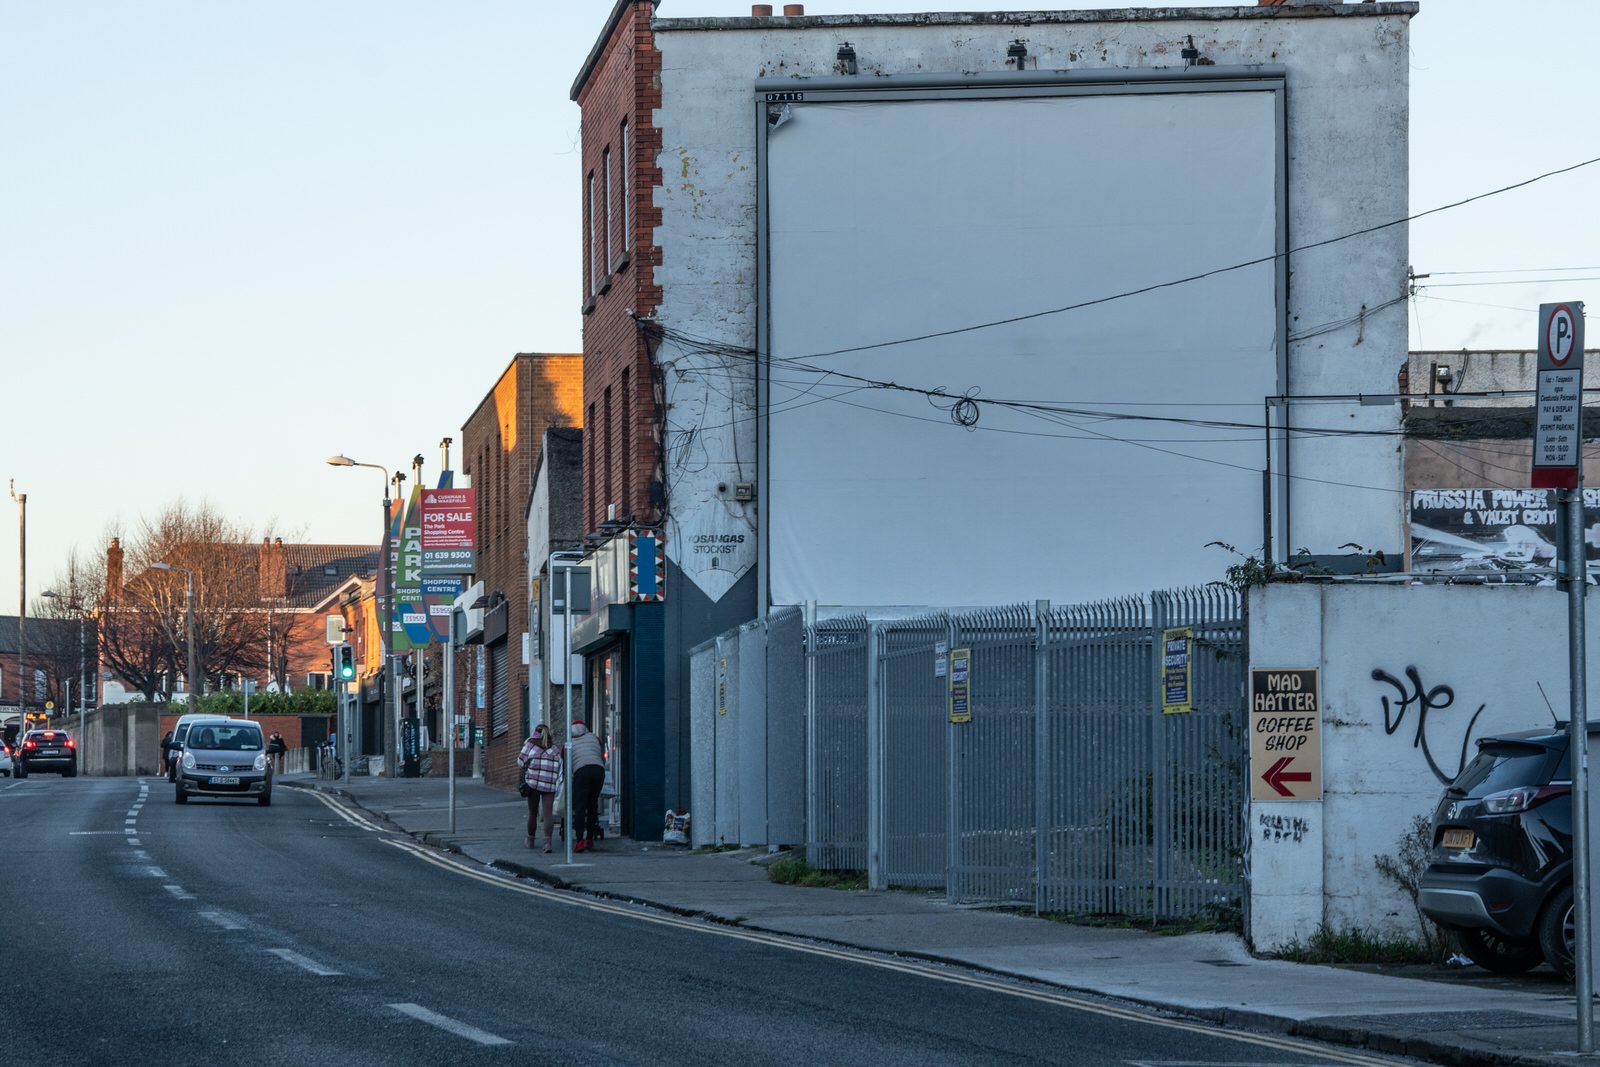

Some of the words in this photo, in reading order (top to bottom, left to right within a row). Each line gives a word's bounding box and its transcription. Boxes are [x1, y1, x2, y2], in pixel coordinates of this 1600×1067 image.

[768, 93, 802, 101] 07115
[1491, 489, 1548, 509] POWER
[424, 513, 445, 522] FOR
[446, 512, 472, 522] SALE
[1463, 510, 1474, 525] &
[1477, 509, 1519, 525] VALET
[1523, 509, 1557, 525] CENT
[688, 534, 745, 544] OSANGAS
[404, 527, 422, 581] PARK
[450, 551, 471, 559] 9300
[693, 545, 737, 554] STOCKIST
[1268, 673, 1302, 691] MAD
[1255, 692, 1315, 711] HATTER
[1256, 717, 1315, 733] COFFEE
[1265, 735, 1308, 751] SHOP
